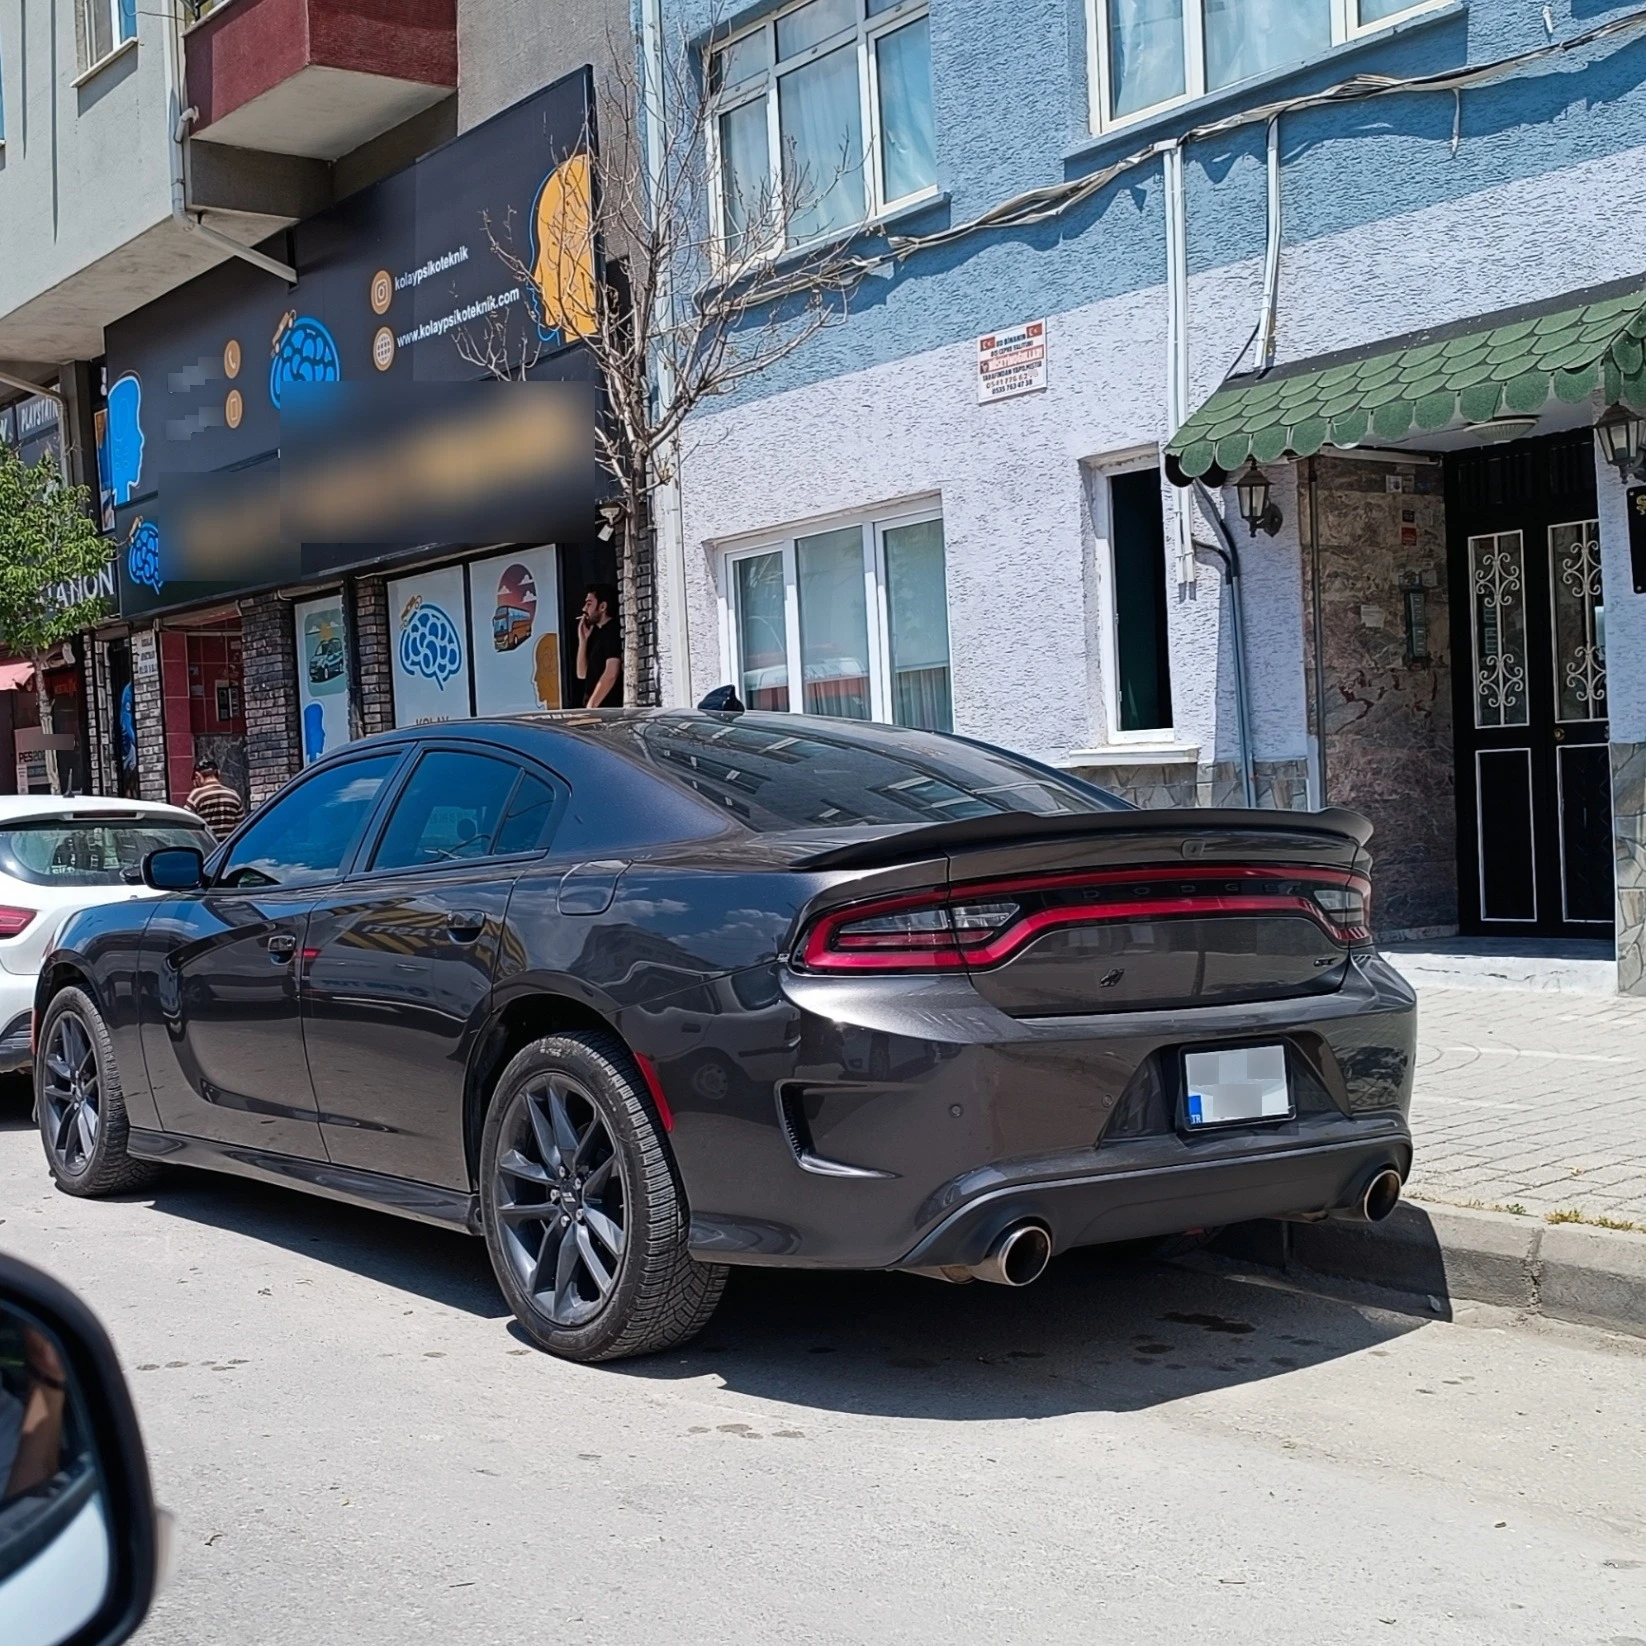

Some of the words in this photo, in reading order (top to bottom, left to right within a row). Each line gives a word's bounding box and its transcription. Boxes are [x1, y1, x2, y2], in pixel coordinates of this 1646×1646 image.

[394, 245, 469, 291] kolaypsikoteknik
[397, 287, 520, 348] www.kolaypsikoteknik.com
[1083, 883, 1280, 899] DODGE
[1191, 1114, 1202, 1124] TR
